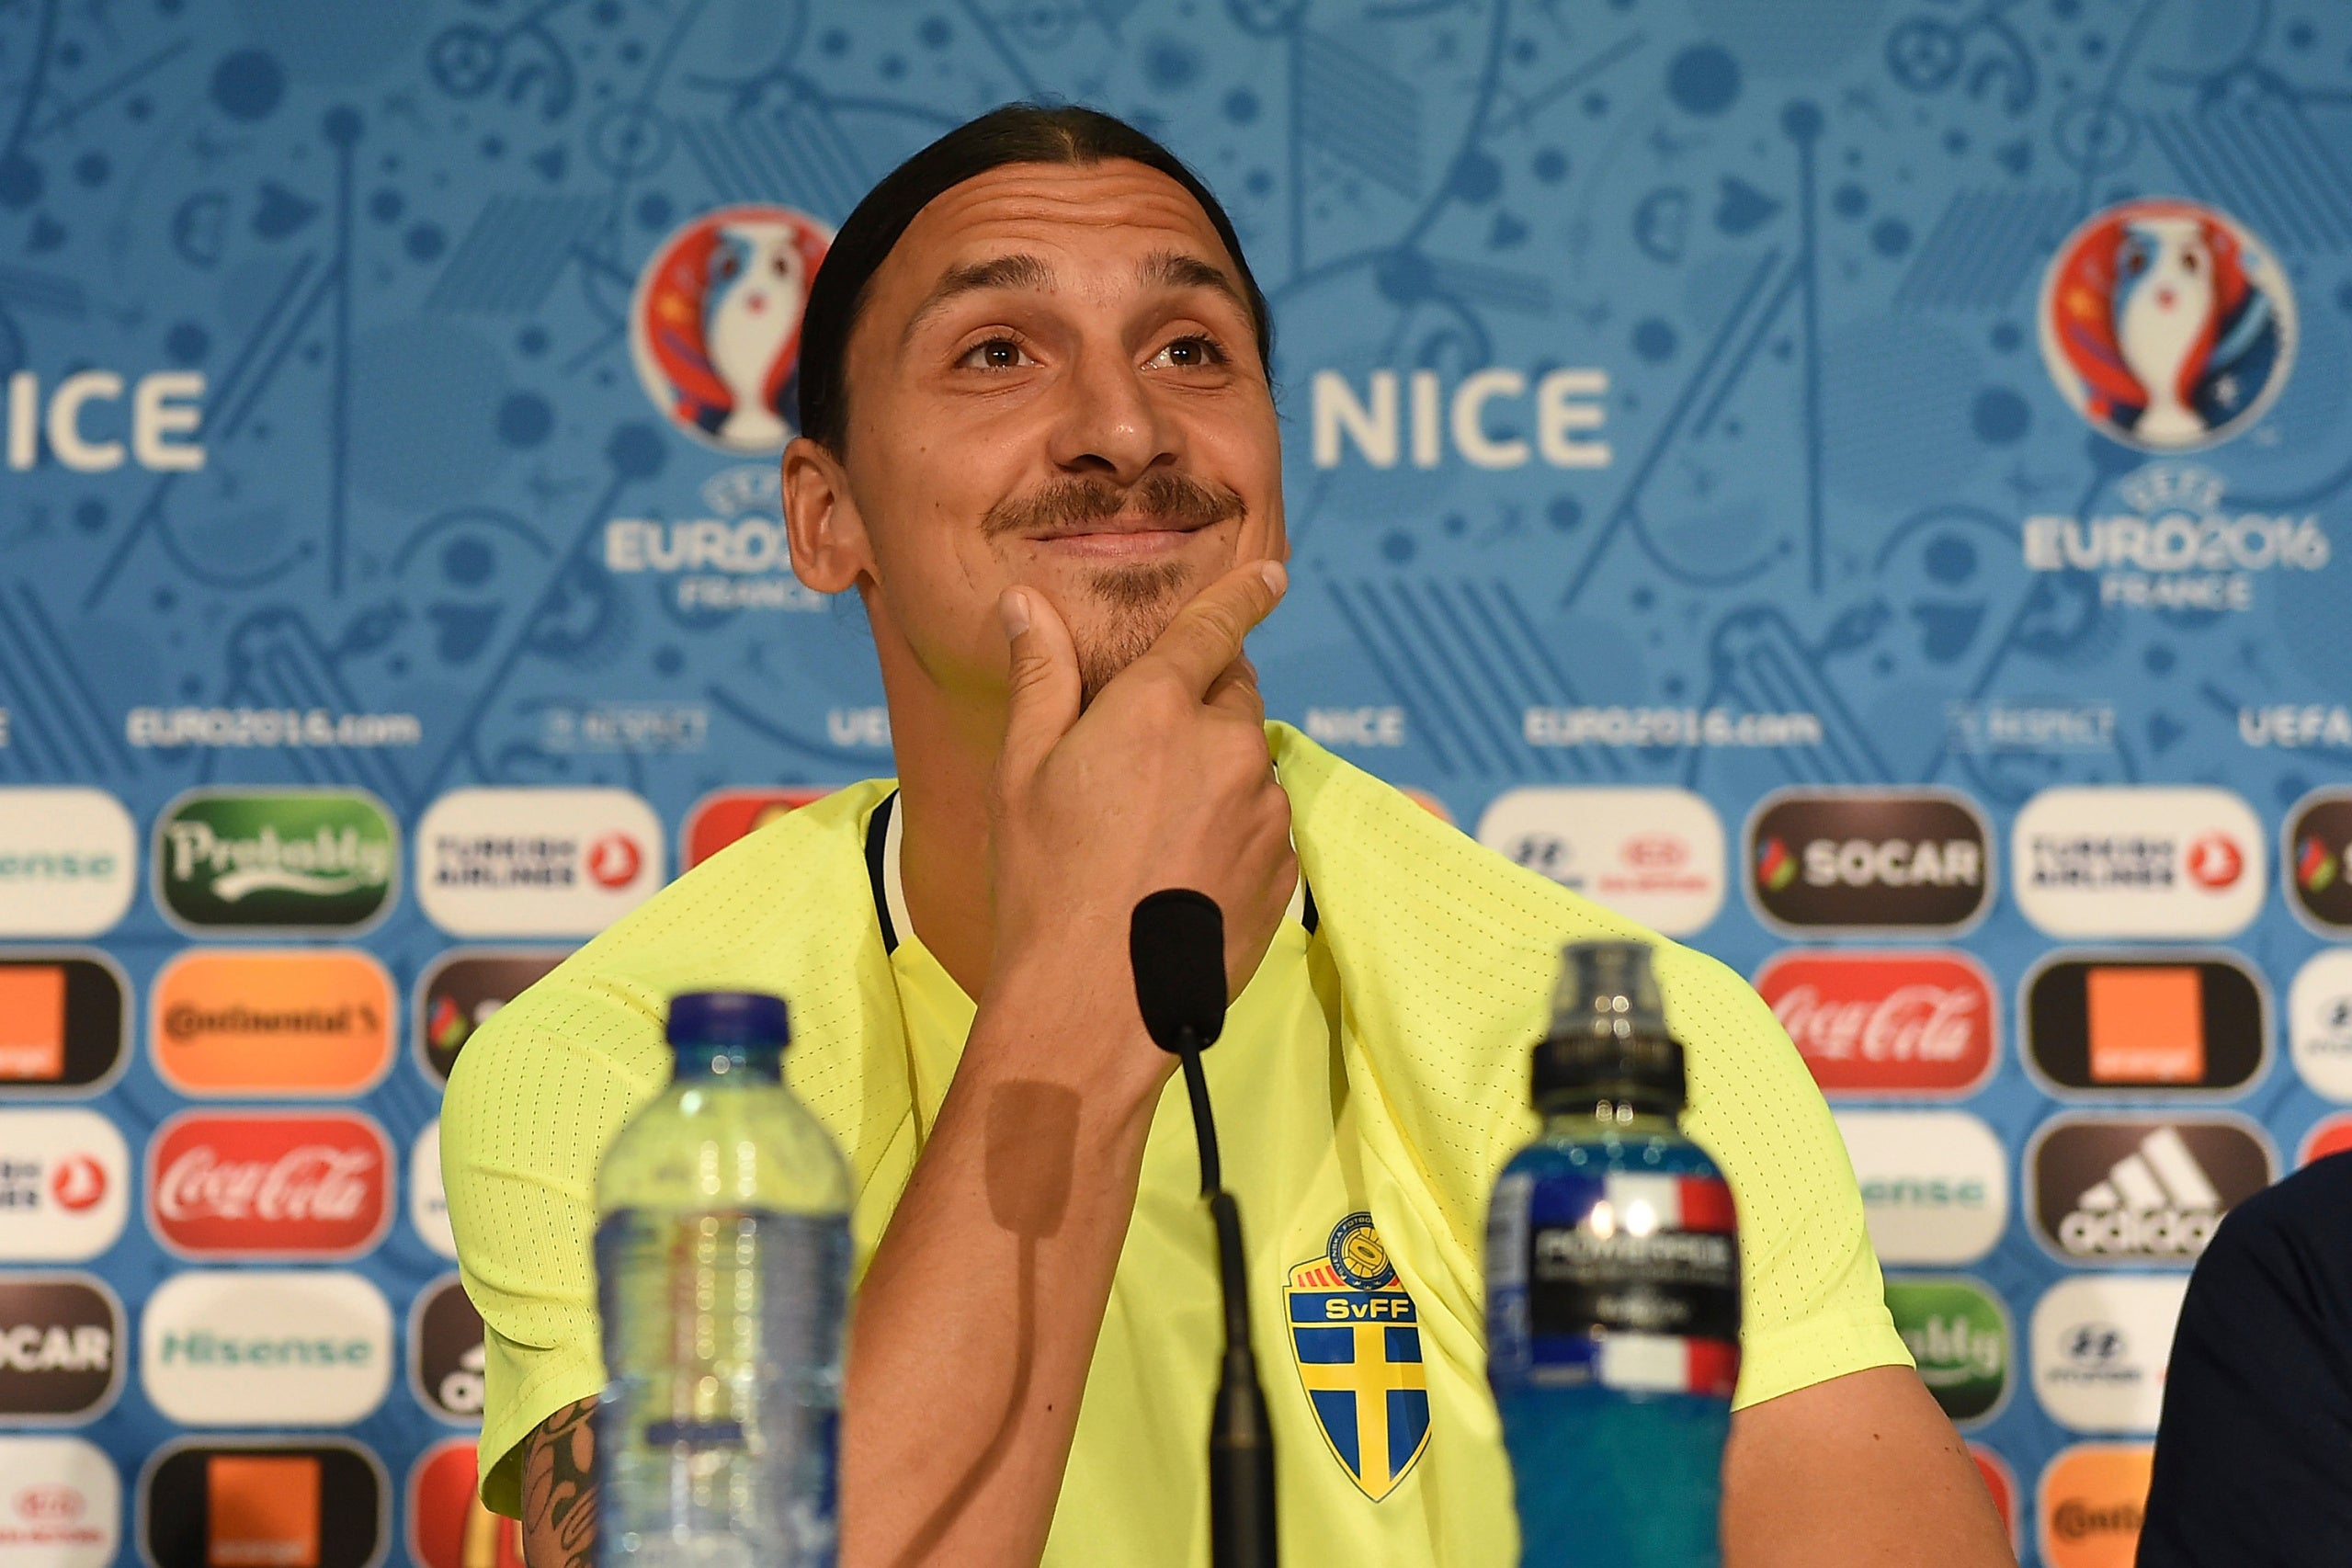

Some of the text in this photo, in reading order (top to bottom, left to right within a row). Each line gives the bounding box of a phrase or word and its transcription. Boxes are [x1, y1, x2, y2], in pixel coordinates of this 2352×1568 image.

[8, 371, 206, 472] ICE
[1312, 370, 1612, 470] NICE
[2101, 574, 2253, 611] FRANCE
[127, 708, 421, 745] EURO2016.com
[1307, 707, 1404, 745] NICE
[1524, 708, 1823, 745] EURO2016.com
[167, 821, 390, 881] Probably
[1804, 839, 1981, 887] SOCAR
[165, 999, 353, 1042] Continental
[156, 1146, 376, 1221] Coca-Cola
[1325, 1299, 1409, 1319] SvFF
[161, 1328, 371, 1367] Hisense
